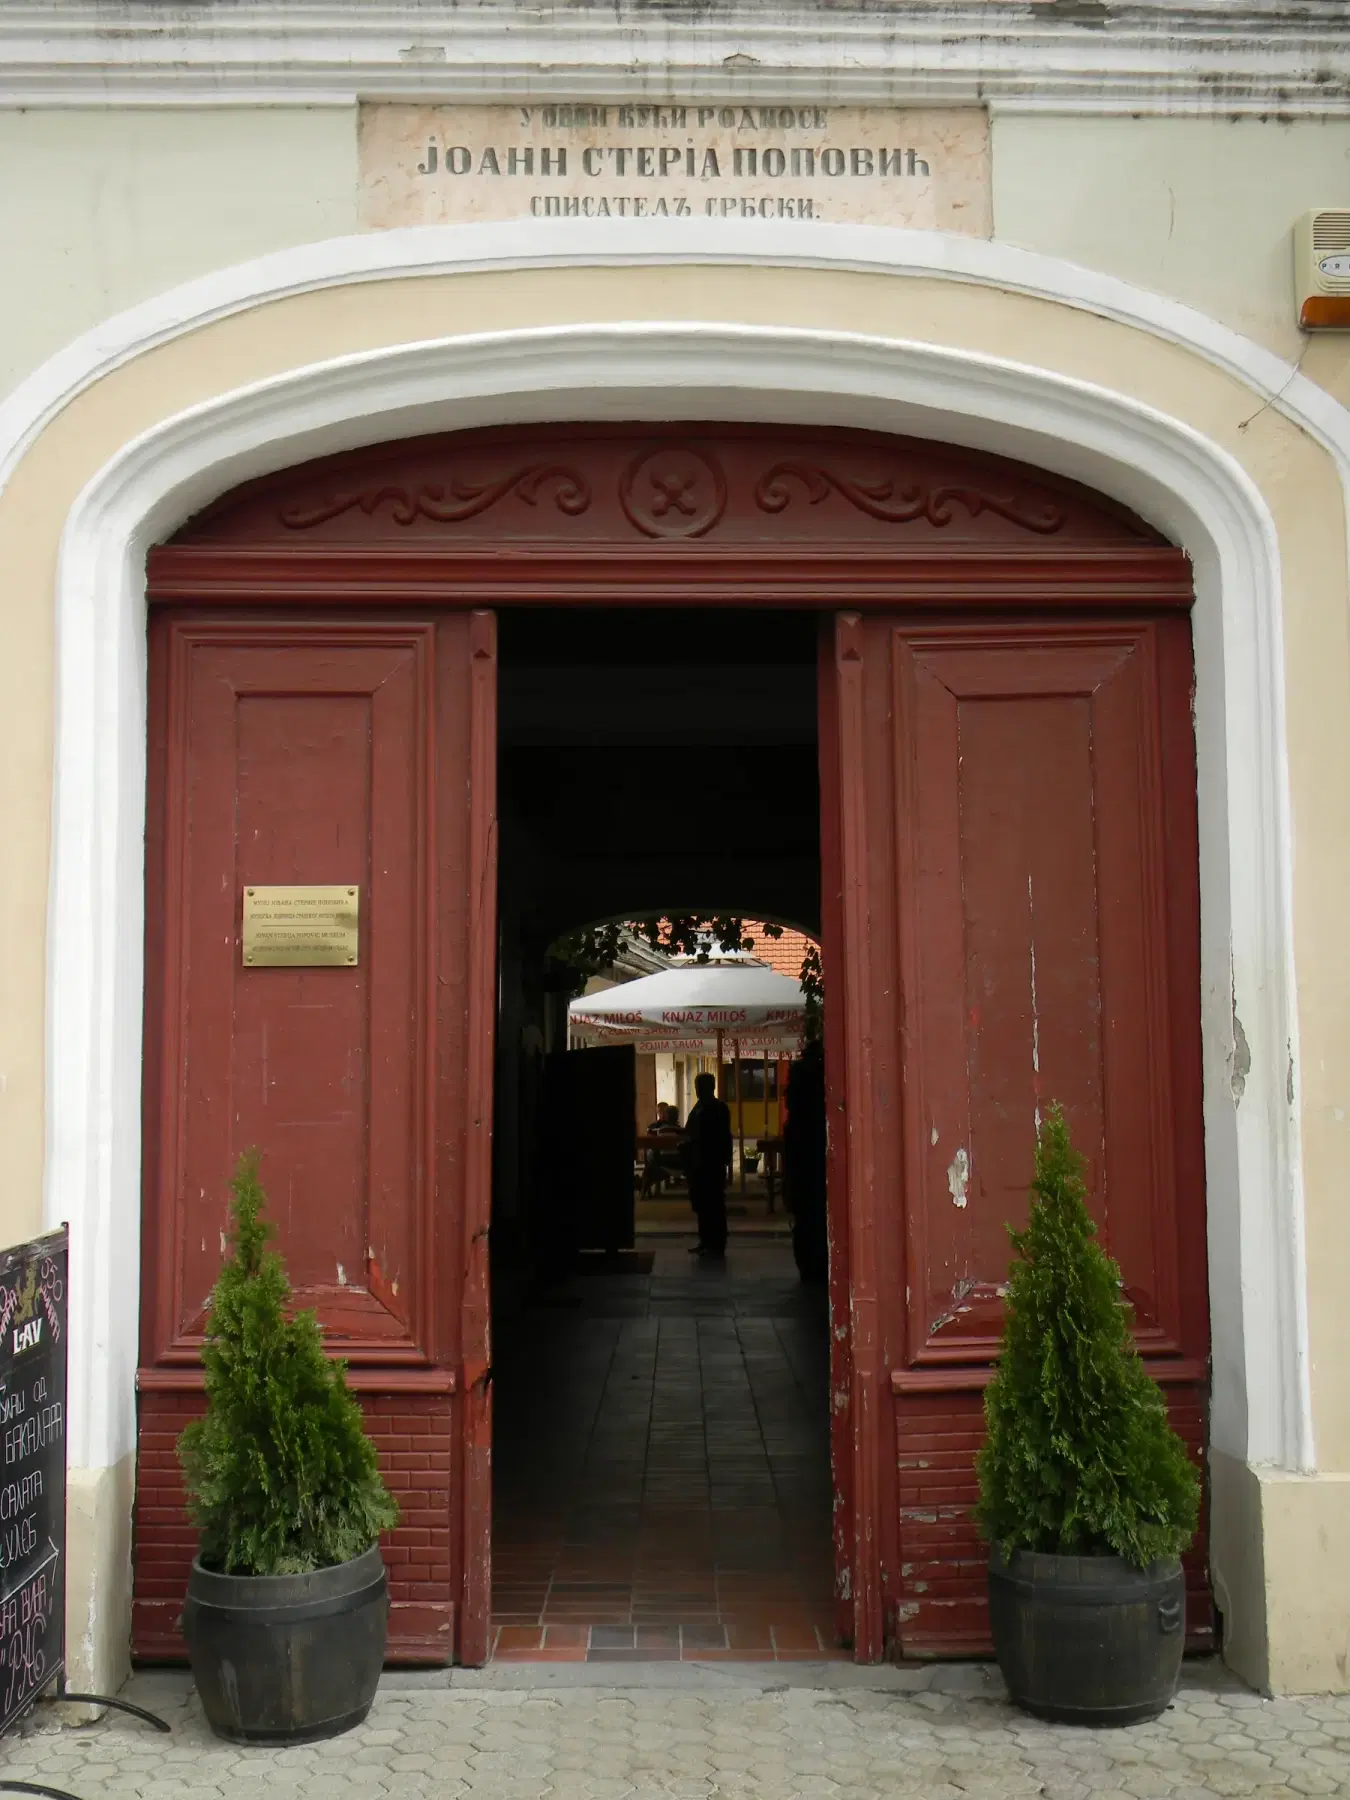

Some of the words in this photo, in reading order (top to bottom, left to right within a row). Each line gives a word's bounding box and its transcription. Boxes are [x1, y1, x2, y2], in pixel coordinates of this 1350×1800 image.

[604, 1010, 643, 1024] MILOŠ
[662, 1011, 702, 1023] KNJAZ
[707, 1009, 747, 1022] MILOŠ
[13, 1317, 42, 1355] LAV
